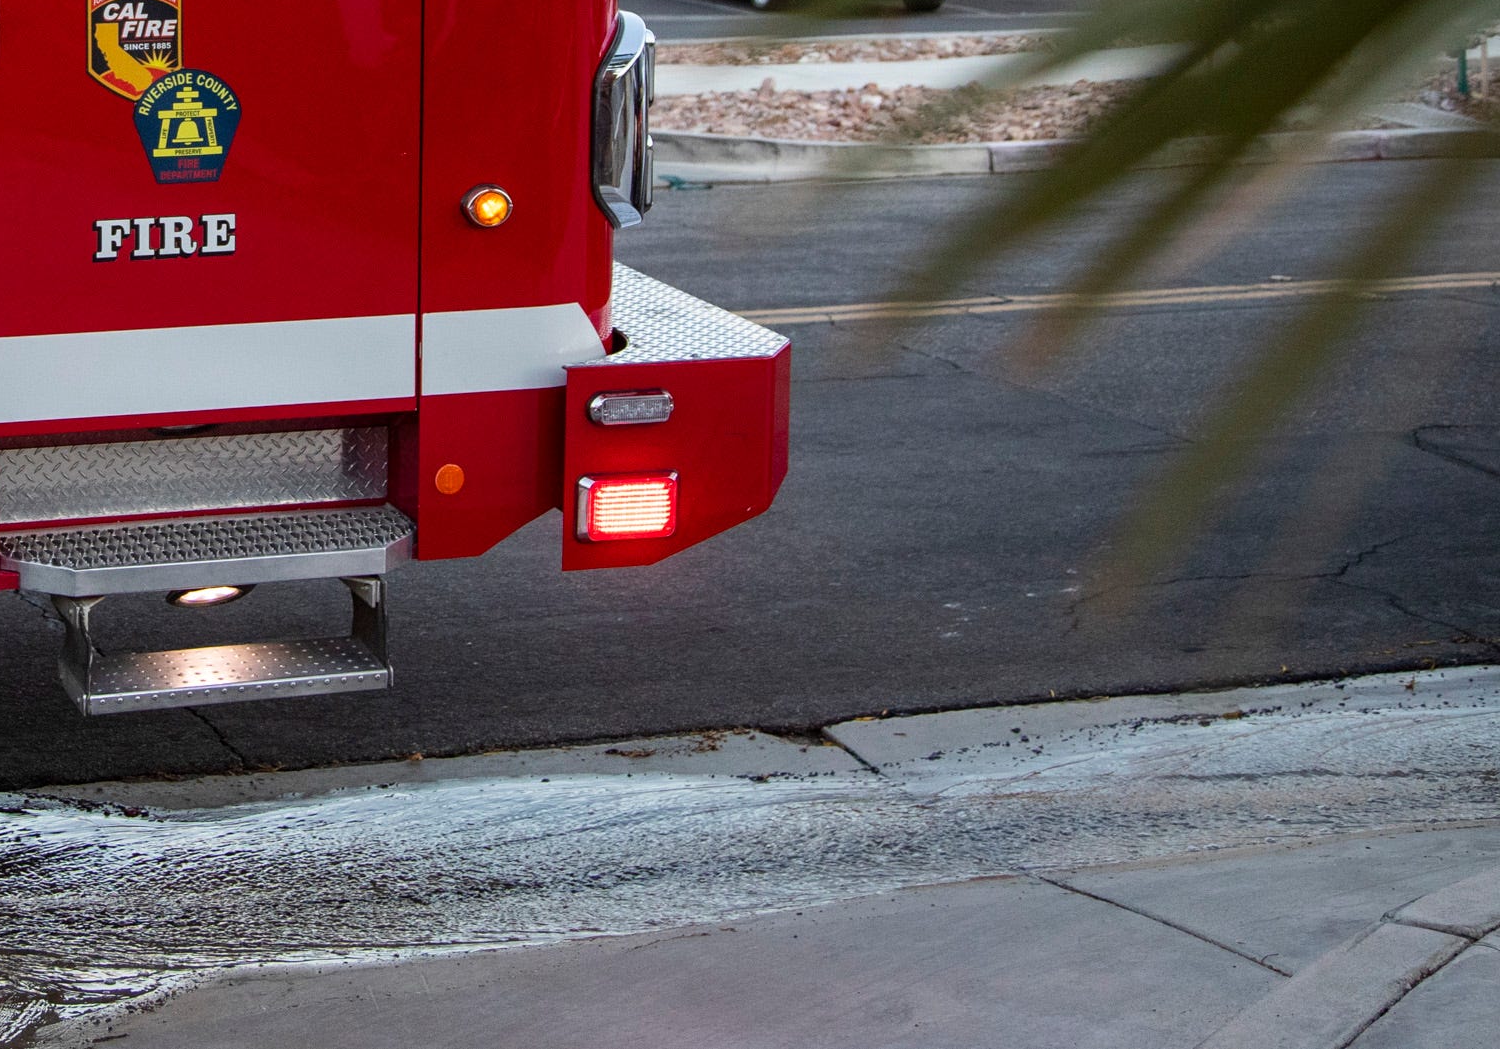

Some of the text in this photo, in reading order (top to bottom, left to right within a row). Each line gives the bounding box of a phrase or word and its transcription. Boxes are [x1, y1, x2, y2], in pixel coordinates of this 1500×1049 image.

[103, 2, 149, 21] CAL
[121, 19, 178, 39] FIRE
[123, 41, 172, 51] SINCE 1885
[138, 72, 238, 116] RIVERSIDE COUNTY
[174, 148, 203, 156] PRESERVE
[177, 158, 200, 169] FIRE
[160, 168, 218, 181] DEPARTMENT
[92, 213, 237, 263] FIRE
